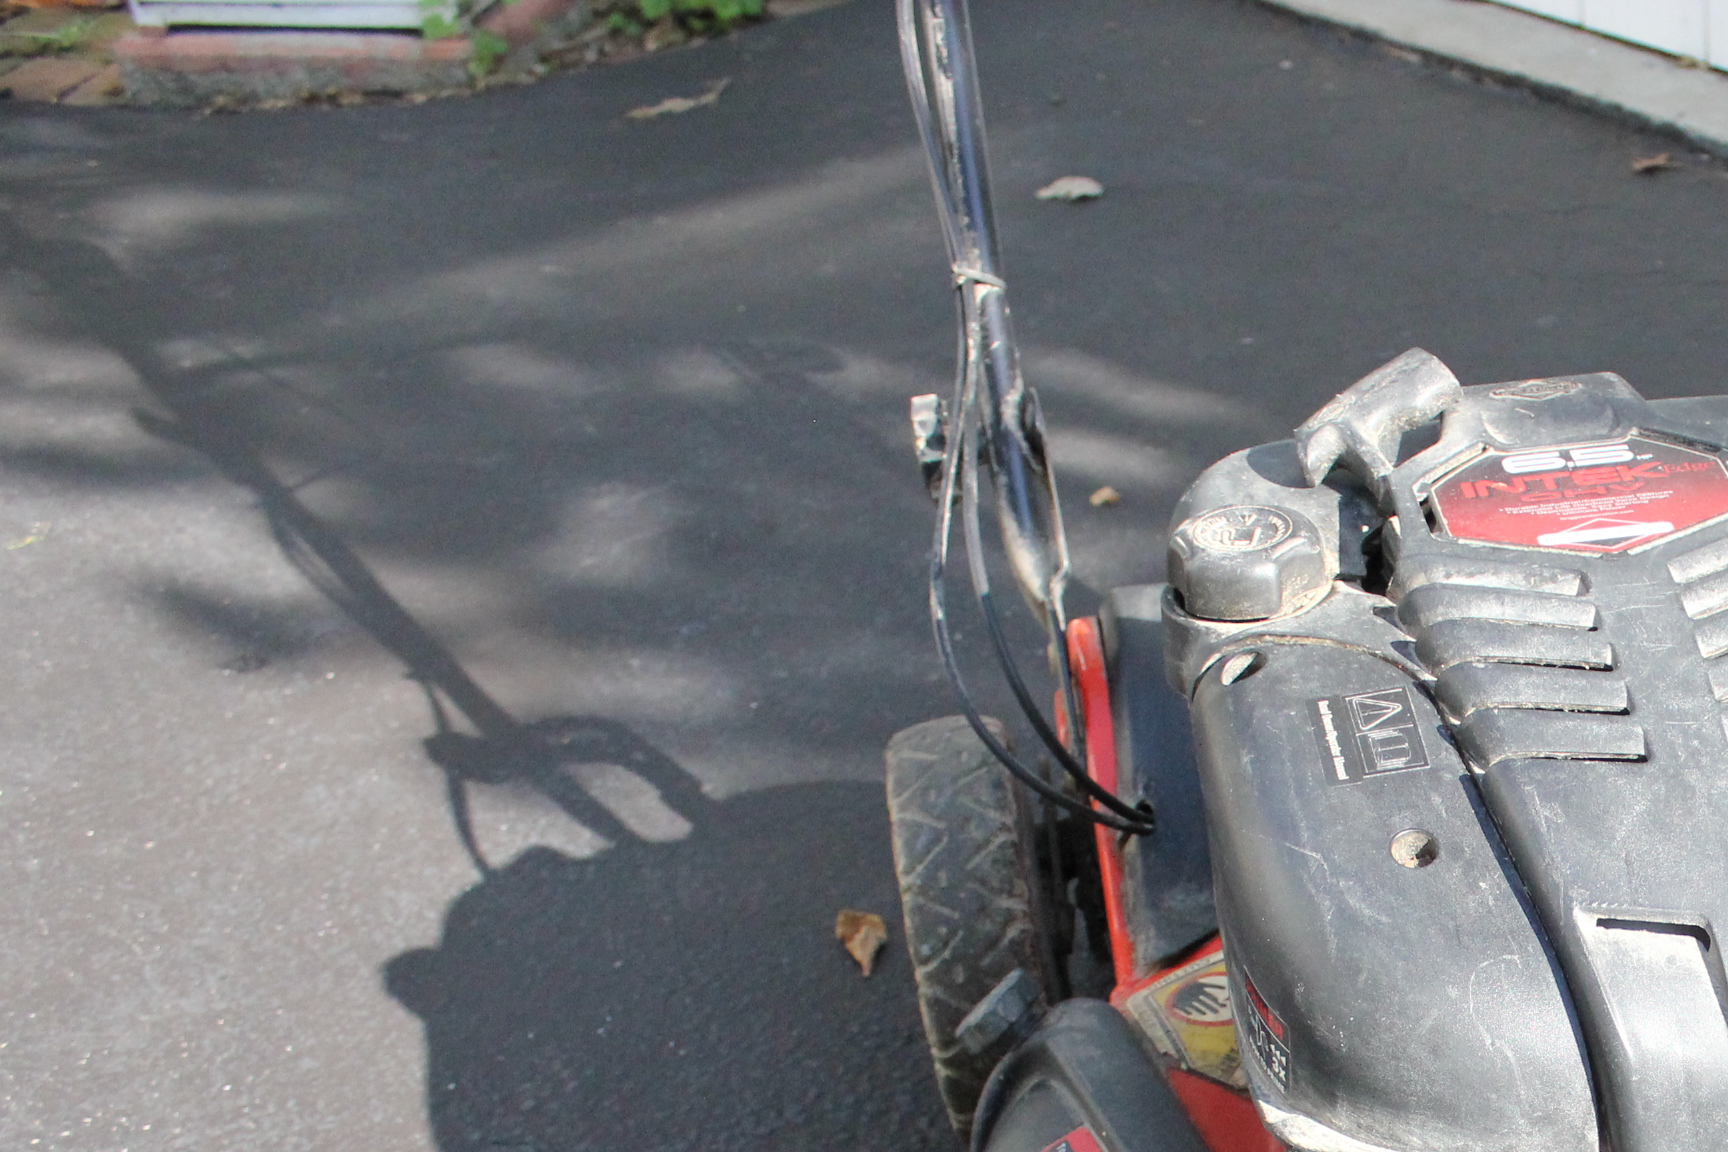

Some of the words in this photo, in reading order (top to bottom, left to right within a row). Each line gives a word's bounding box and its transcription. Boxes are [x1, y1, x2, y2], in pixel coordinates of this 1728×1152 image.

[1501, 444, 1634, 474] 6.5
[1459, 461, 1669, 498] INTEK
[1664, 461, 1717, 475] Edge
[1520, 482, 1645, 502] OHV
[1540, 494, 1635, 508] Industrial/Commercial
[1573, 500, 1615, 508] Overhead
[1562, 508, 1598, 516] Ultimate
